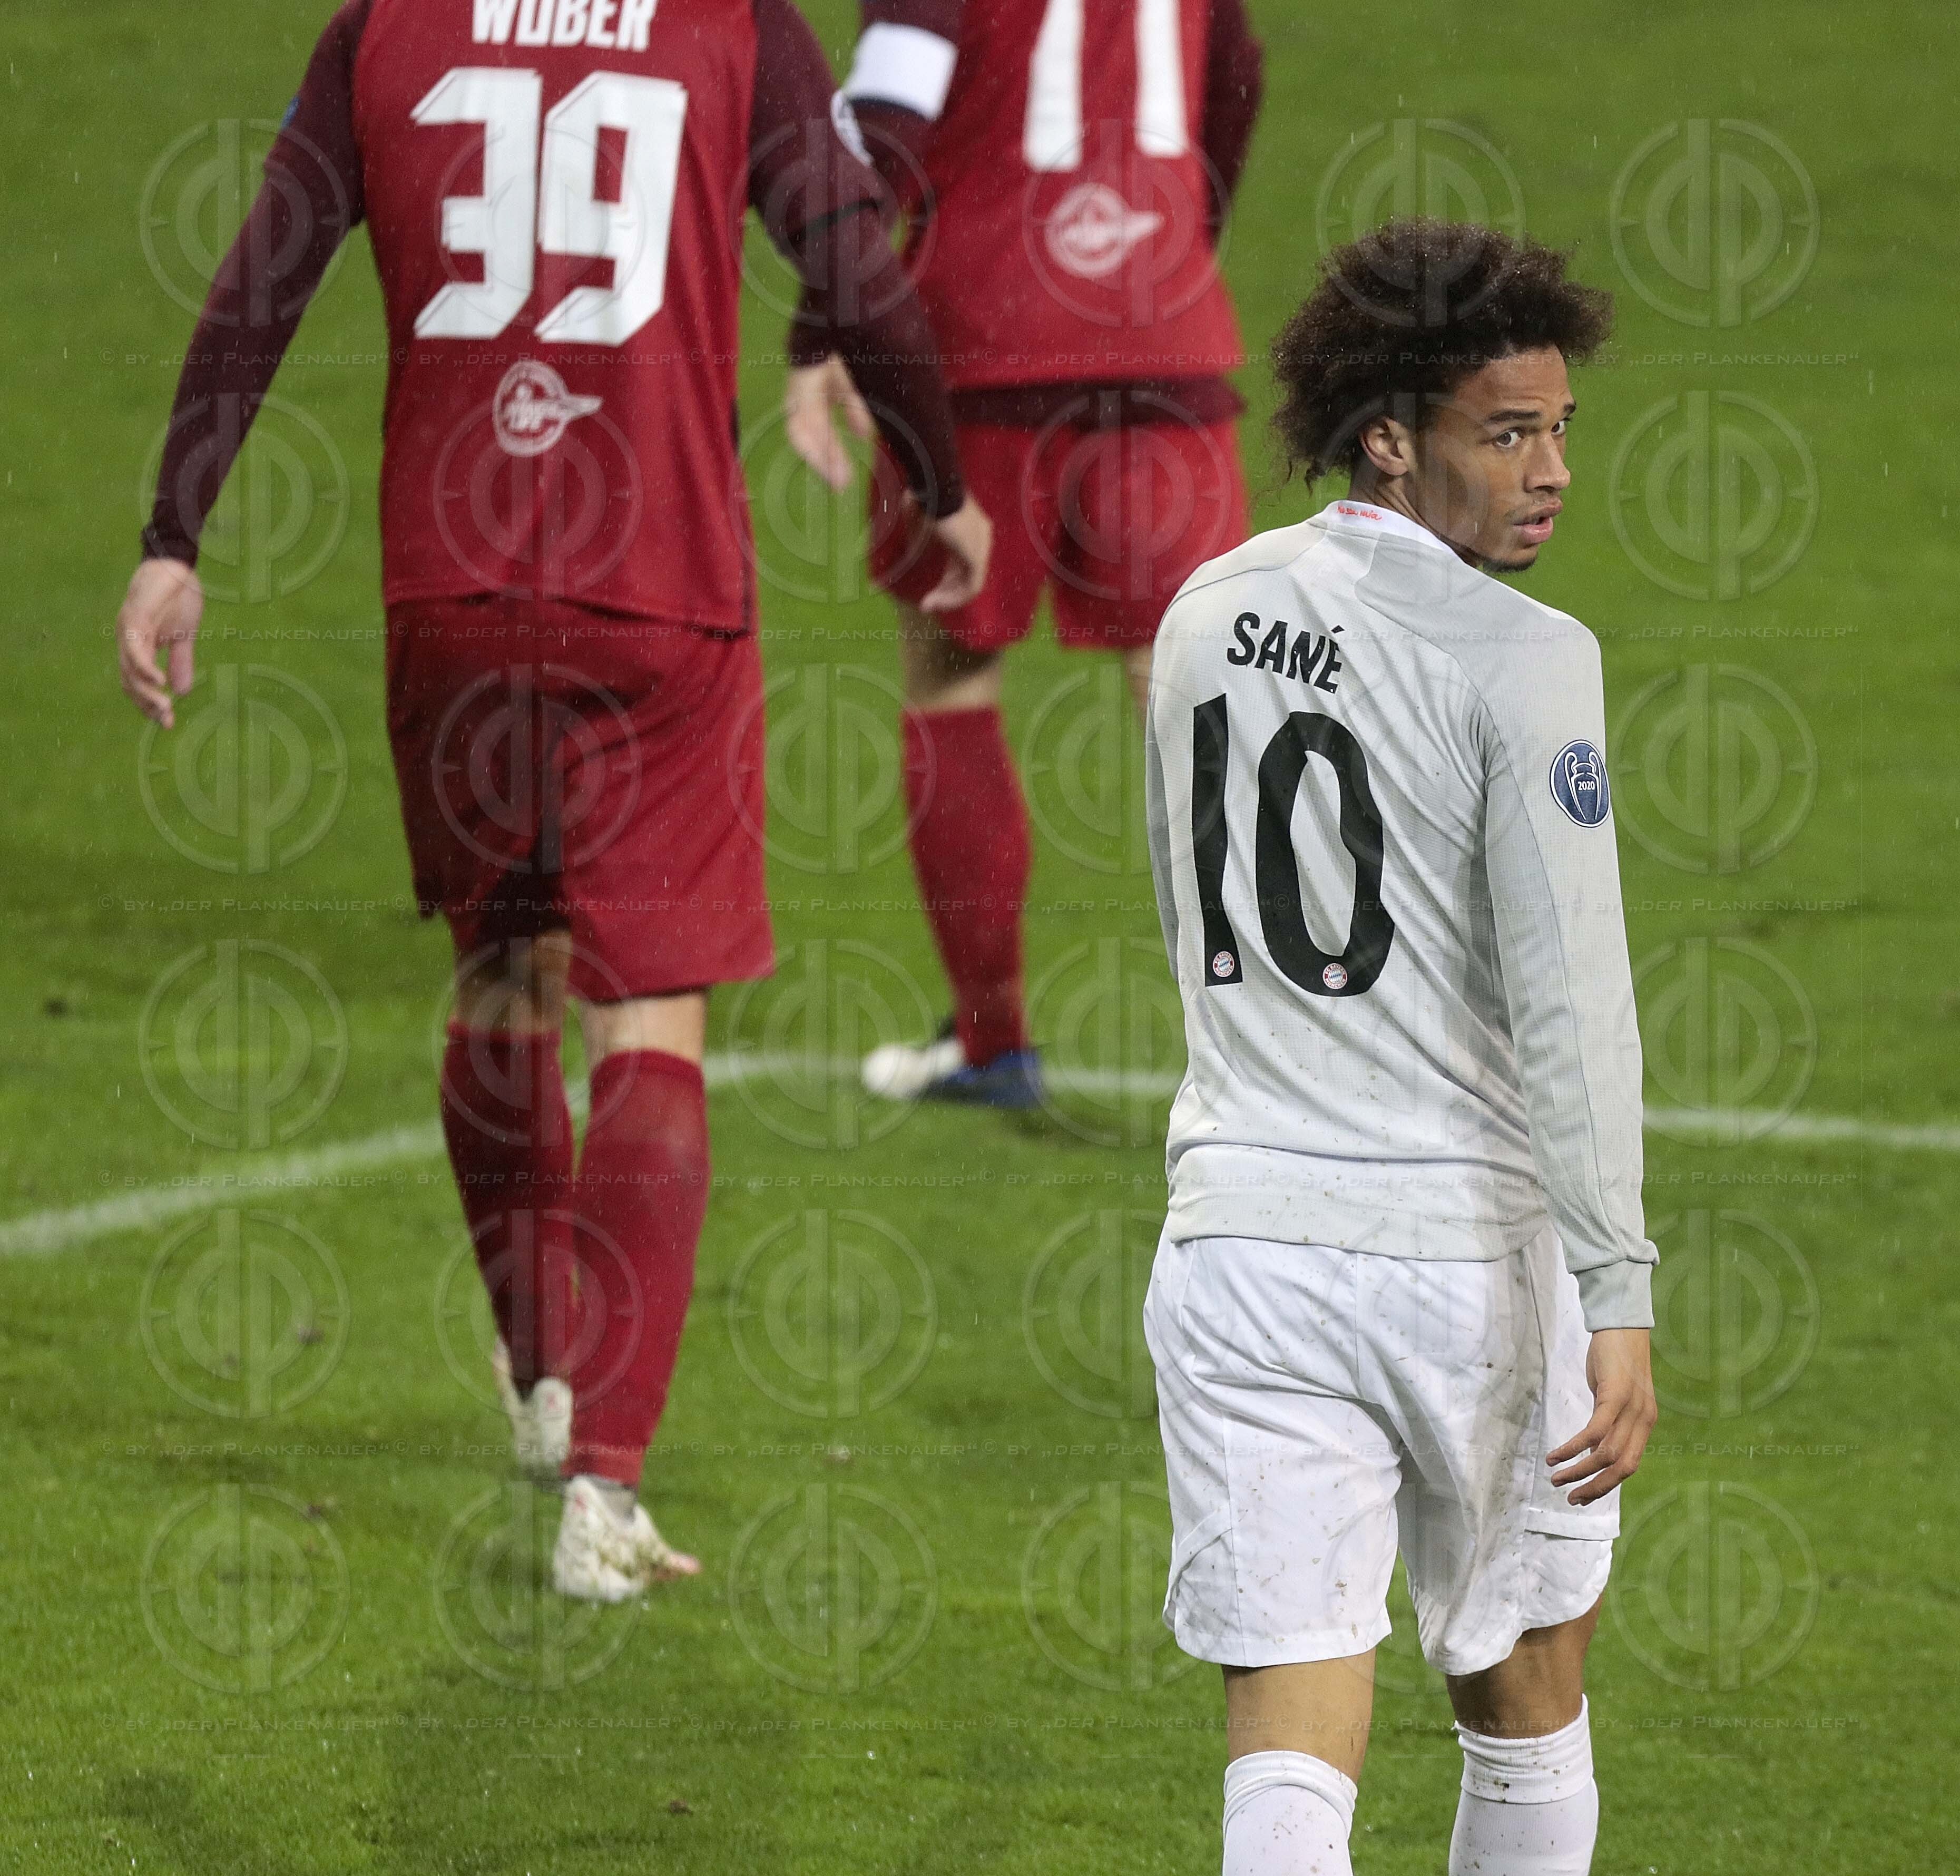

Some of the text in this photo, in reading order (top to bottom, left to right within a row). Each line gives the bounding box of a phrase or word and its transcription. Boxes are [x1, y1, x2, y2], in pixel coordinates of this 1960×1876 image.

[410, 66, 688, 346] 39
[1227, 612, 1345, 694] SANÉ
[1192, 693, 1395, 997] 10
[1577, 781, 1595, 790] 2020
